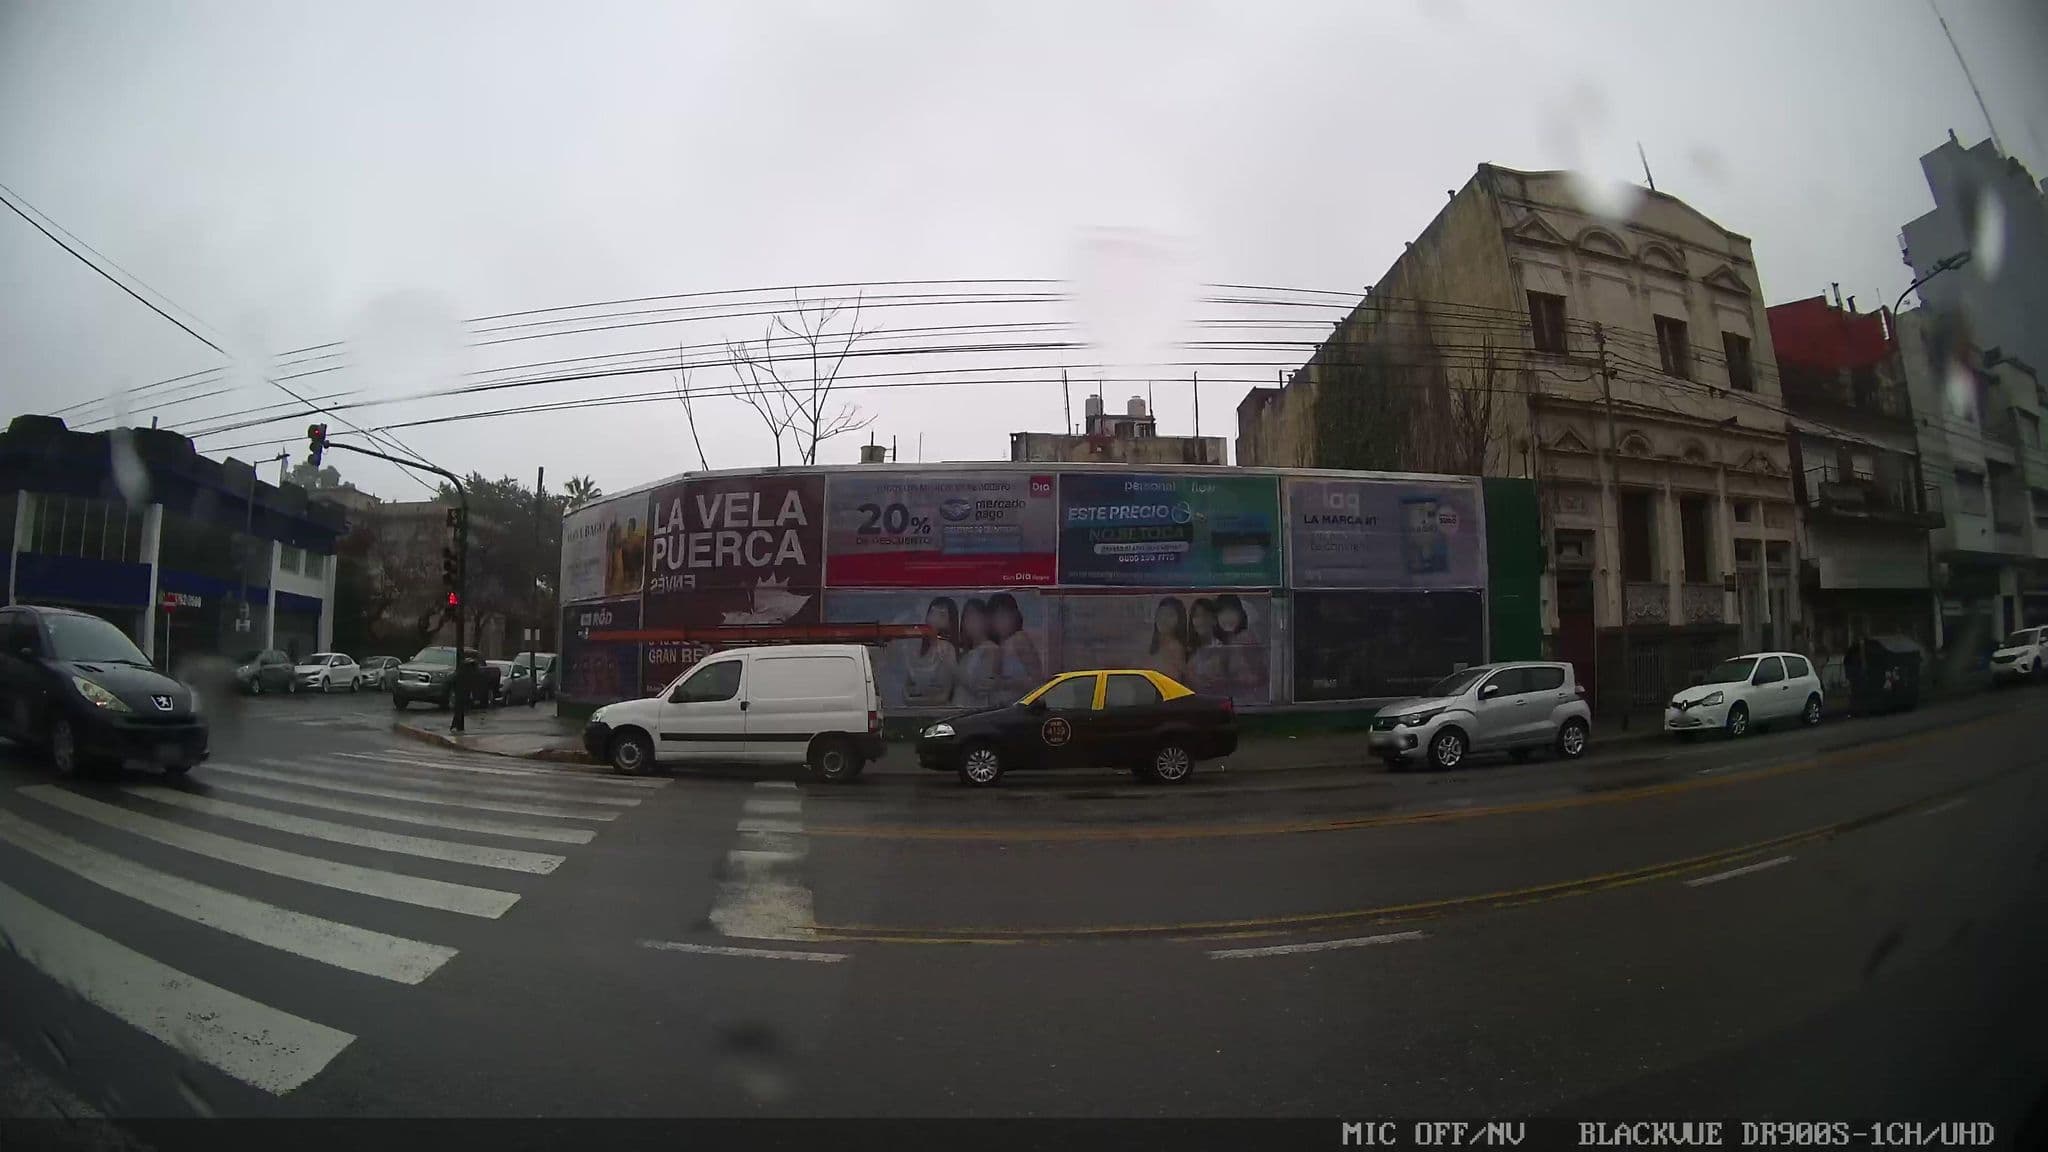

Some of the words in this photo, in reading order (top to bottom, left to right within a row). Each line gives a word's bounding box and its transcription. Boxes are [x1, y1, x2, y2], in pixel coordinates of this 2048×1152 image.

[653, 497, 685, 534] LA
[696, 490, 808, 529] VELA
[975, 499, 1027, 510] mercado
[1067, 506, 1107, 520] ESTE
[1109, 504, 1170, 519] PRECIO
[857, 502, 931, 535] 20%
[975, 510, 1004, 521] pago
[1303, 514, 1319, 525] LA
[1322, 515, 1363, 525] MARCA
[651, 529, 807, 572] PUERCA
[649, 648, 677, 664] GRAN
